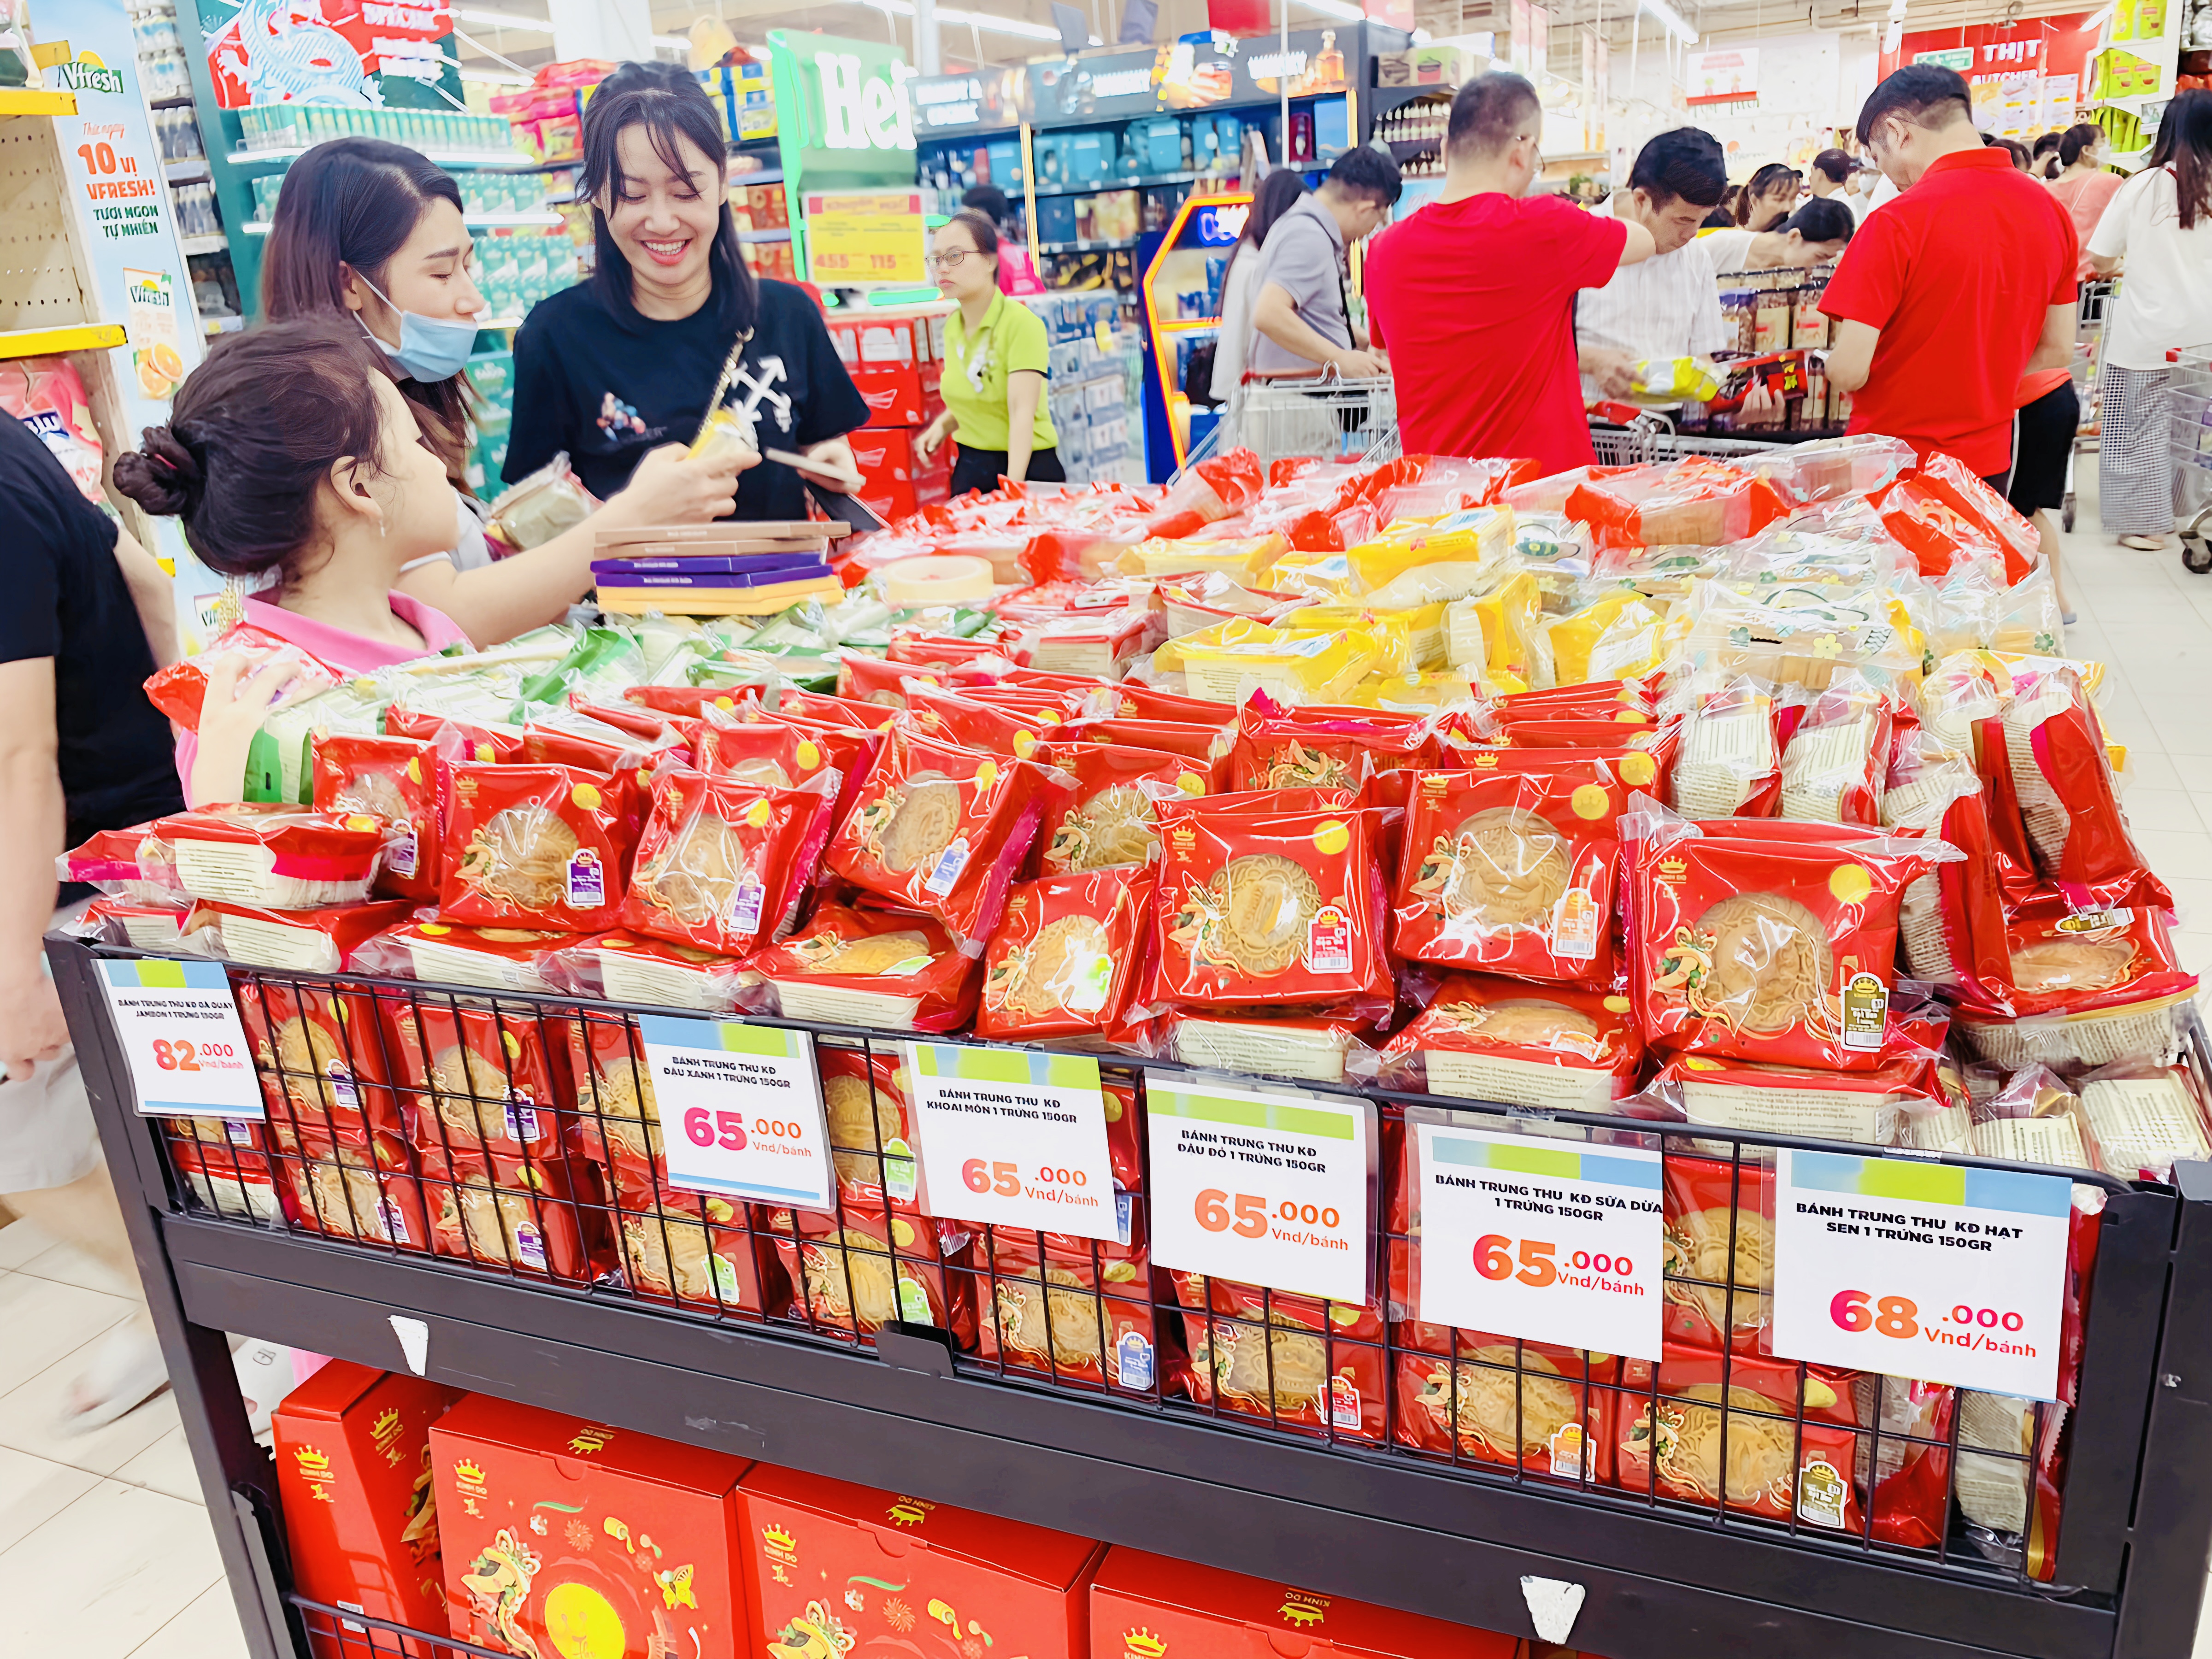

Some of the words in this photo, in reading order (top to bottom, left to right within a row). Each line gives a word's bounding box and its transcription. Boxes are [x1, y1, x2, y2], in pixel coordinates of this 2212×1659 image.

[1983, 39, 2042, 63] THỊT
[64, 63, 122, 93] Vfresh
[77, 142, 116, 175] 10
[120, 157, 138, 176] VỊ
[86, 179, 156, 200] VFRESH!
[124, 205, 159, 219] NGON
[153, 1039, 200, 1071] 82
[200, 1043, 234, 1057] .000
[672, 1056, 700, 1066] BÁNH
[702, 1059, 736, 1070] TRUNG
[738, 1063, 759, 1072] THU
[687, 1070, 715, 1079] XANH
[723, 1074, 758, 1084] TRỨNG
[759, 1077, 791, 1088] 150GR
[939, 1088, 971, 1100] BÁNH
[973, 1093, 1012, 1103] TRUNG
[1015, 1096, 1038, 1106] THU
[927, 1101, 962, 1112] KHOAI
[965, 1103, 990, 1115] MÔN
[1000, 1107, 1039, 1119] TRỨNG
[1042, 1112, 1077, 1123] 150GR
[684, 1107, 747, 1151] 65
[751, 1118, 801, 1139] .000
[753, 1141, 812, 1157] Vnd/bánh
[1182, 1130, 1217, 1143] BÁNH
[1220, 1135, 1264, 1149] TRUNG
[1268, 1141, 1294, 1153] THU
[1230, 1151, 1235, 1159] 1
[1238, 1152, 1282, 1166] TRỨNG
[1286, 1159, 1326, 1173] 150GR
[962, 1158, 1021, 1197] 65
[1035, 1166, 1087, 1187] .000
[1025, 1186, 1098, 1207] Vnd/bánh
[1435, 1174, 1476, 1189] BÁNH
[1479, 1180, 1529, 1196] TRUNG
[1533, 1187, 1563, 1200] THU
[1595, 1195, 1627, 1209] SỮA
[1630, 1200, 1663, 1213] DỪA
[1194, 1188, 1268, 1239] 65
[1272, 1201, 1340, 1229] .000
[1494, 1197, 1501, 1207] 1
[1504, 1198, 1554, 1214] TRỨNG
[1558, 1206, 1603, 1221] 150GR
[1796, 1202, 1843, 1218] BÁNH
[1848, 1208, 1906, 1225] TRUNG
[1911, 1216, 1946, 1230] THU
[1985, 1225, 2023, 1240] HẠT
[1272, 1228, 1348, 1251] Vnd/bánh
[1827, 1222, 1859, 1235] SEN
[1864, 1227, 1871, 1236] 1
[1875, 1228, 1934, 1244] TRỨNG
[1938, 1235, 1992, 1252] 150GR
[1473, 1234, 1557, 1287] 65
[1564, 1250, 1633, 1276] .000
[1558, 1271, 1644, 1296] Vnd/bánh
[1830, 1289, 1919, 1339] 68
[1942, 1304, 2024, 1332] .000
[1924, 1327, 2036, 1358] Vnd/bánh
[784, 1552, 798, 1563] DO
[1285, 1592, 1300, 1601] DO
[1303, 1597, 1330, 1607] KINH
